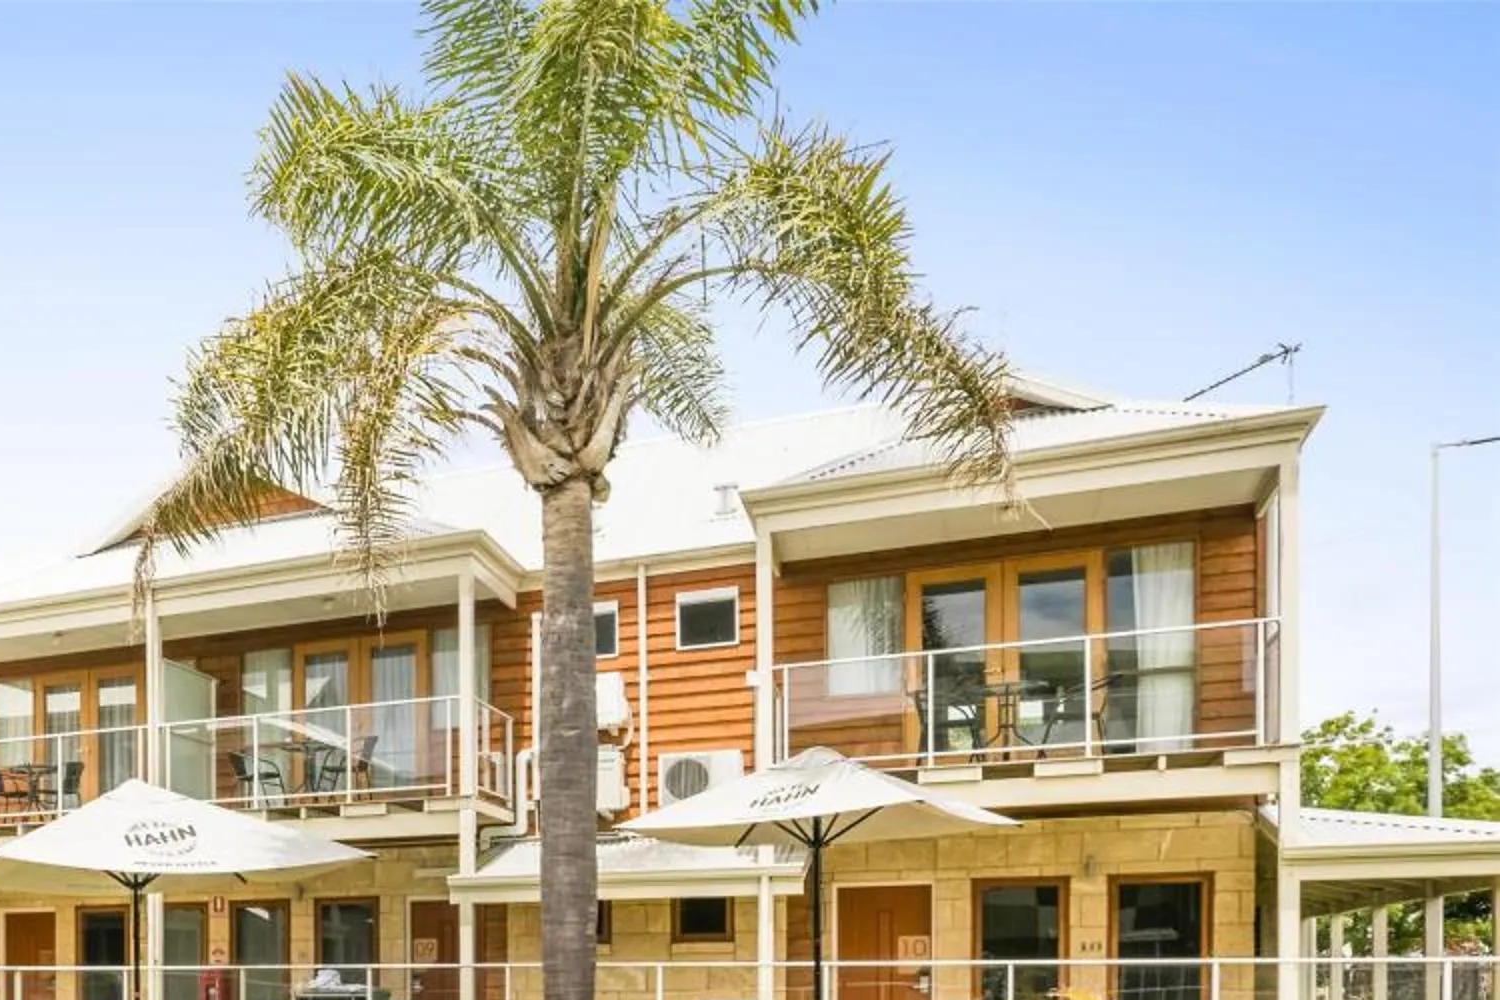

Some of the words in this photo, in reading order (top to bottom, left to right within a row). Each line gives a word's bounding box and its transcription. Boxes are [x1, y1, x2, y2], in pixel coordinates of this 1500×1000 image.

[124, 825, 196, 847] HAHN
[415, 942, 435, 957] 09
[901, 939, 927, 957] 10
